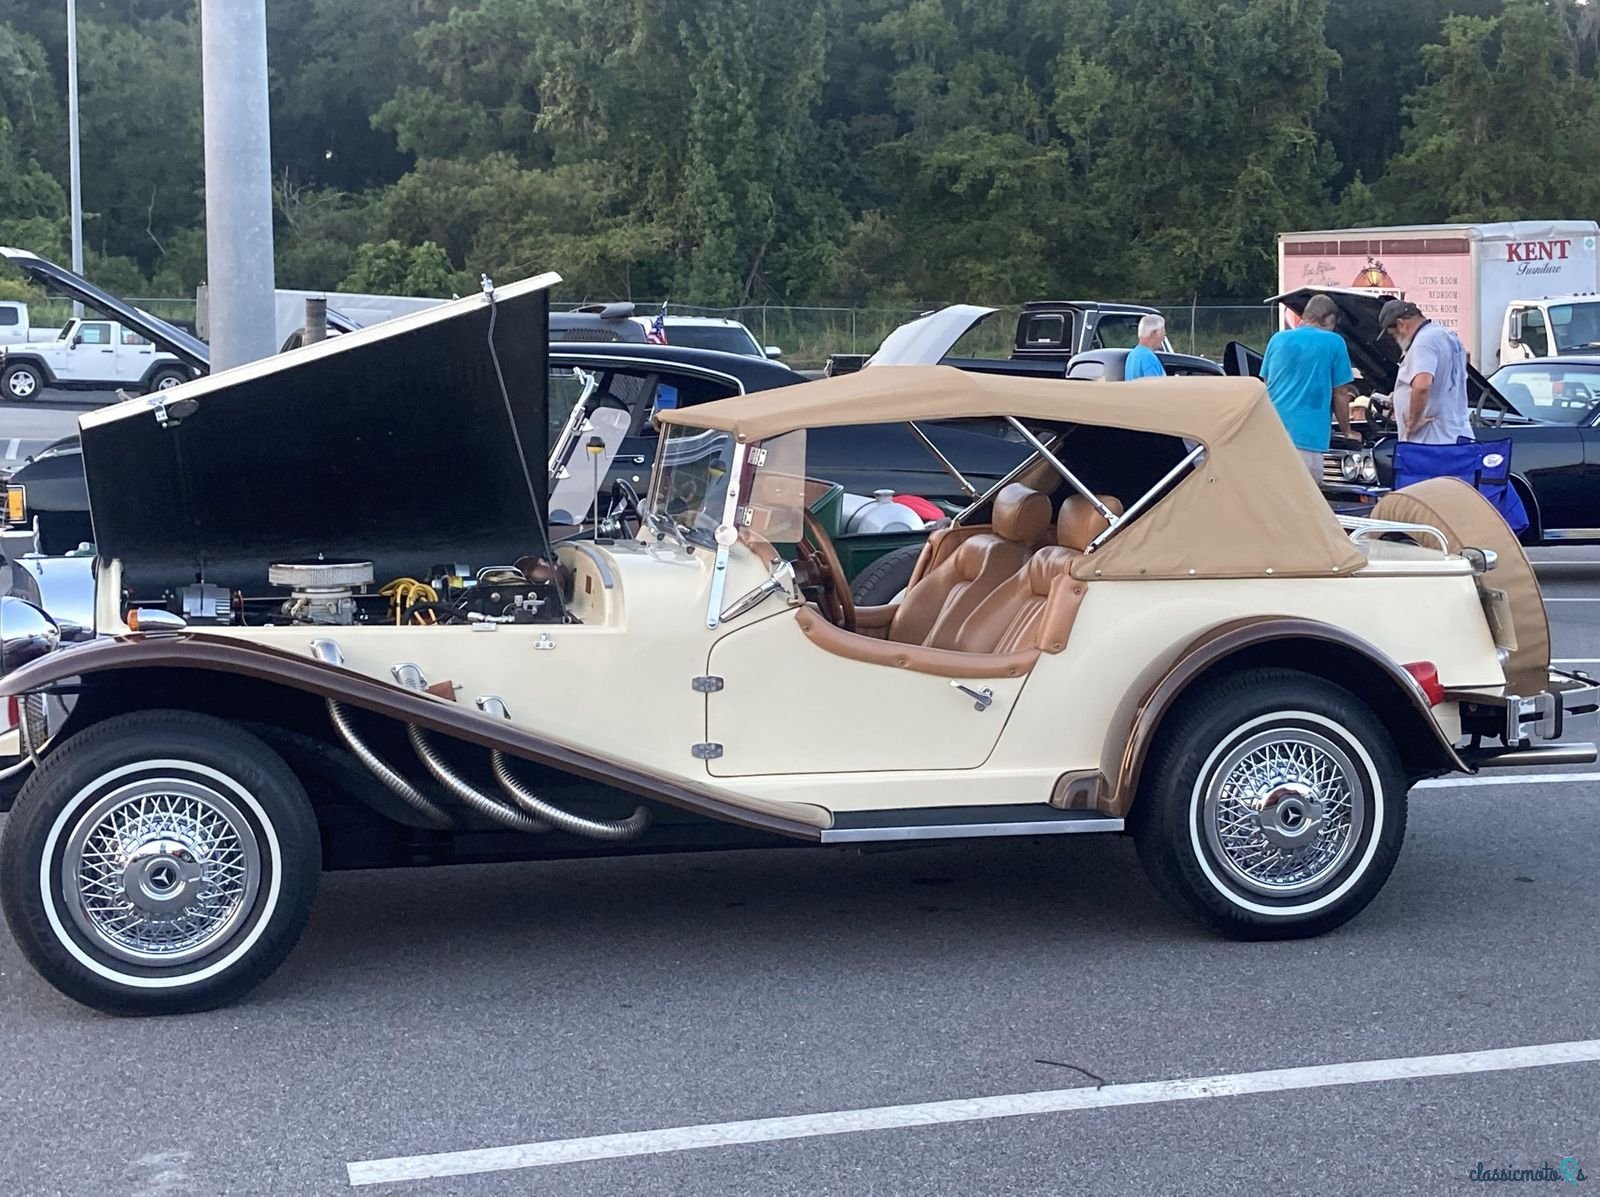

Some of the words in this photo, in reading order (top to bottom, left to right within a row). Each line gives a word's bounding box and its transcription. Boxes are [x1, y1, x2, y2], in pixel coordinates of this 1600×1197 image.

[1506, 239, 1571, 262] KENT
[1440, 276, 1458, 285] ROOM
[1429, 290, 1458, 299] BEDROOM
[1440, 304, 1458, 313] ROOM
